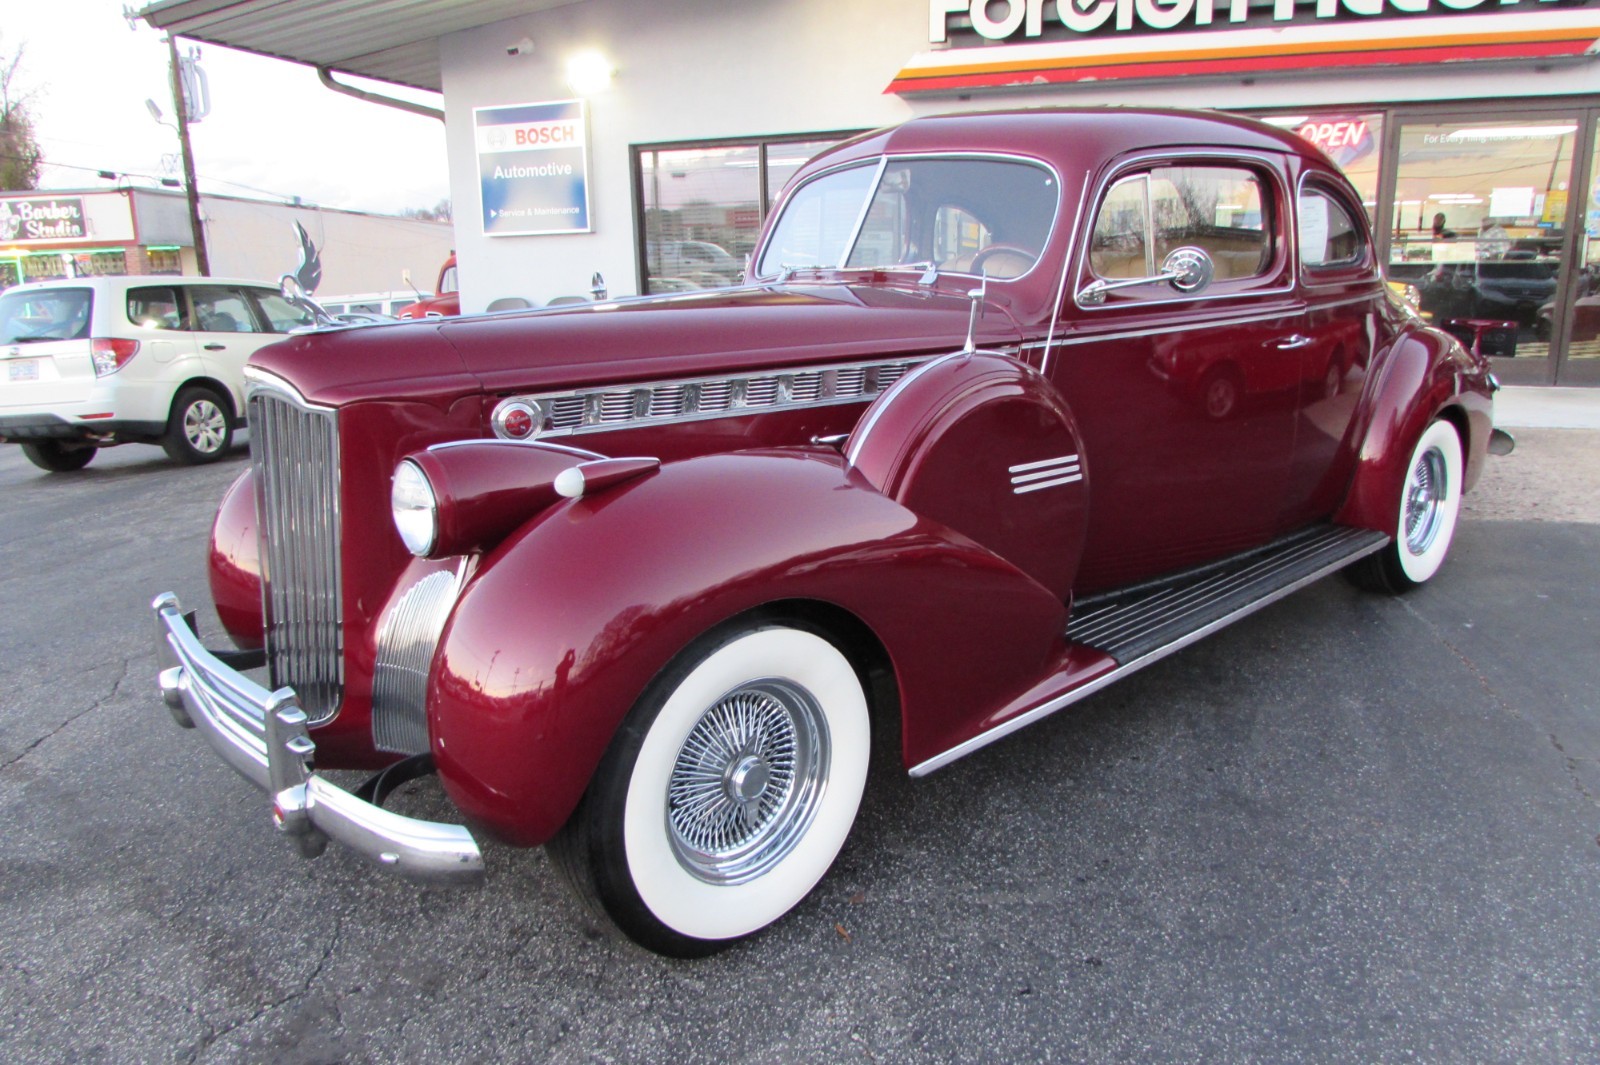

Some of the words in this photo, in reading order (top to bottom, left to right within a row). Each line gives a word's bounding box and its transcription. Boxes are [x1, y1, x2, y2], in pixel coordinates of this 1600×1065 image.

[515, 126, 574, 145] BOSCH
[1299, 122, 1366, 147] OPEN
[1423, 133, 1438, 144] For
[494, 162, 572, 179] Automotive
[17, 202, 80, 220] Barber
[498, 208, 526, 218] Service
[527, 207, 533, 217] &
[534, 206, 580, 217] Maintenance
[26, 220, 82, 238] Studio
